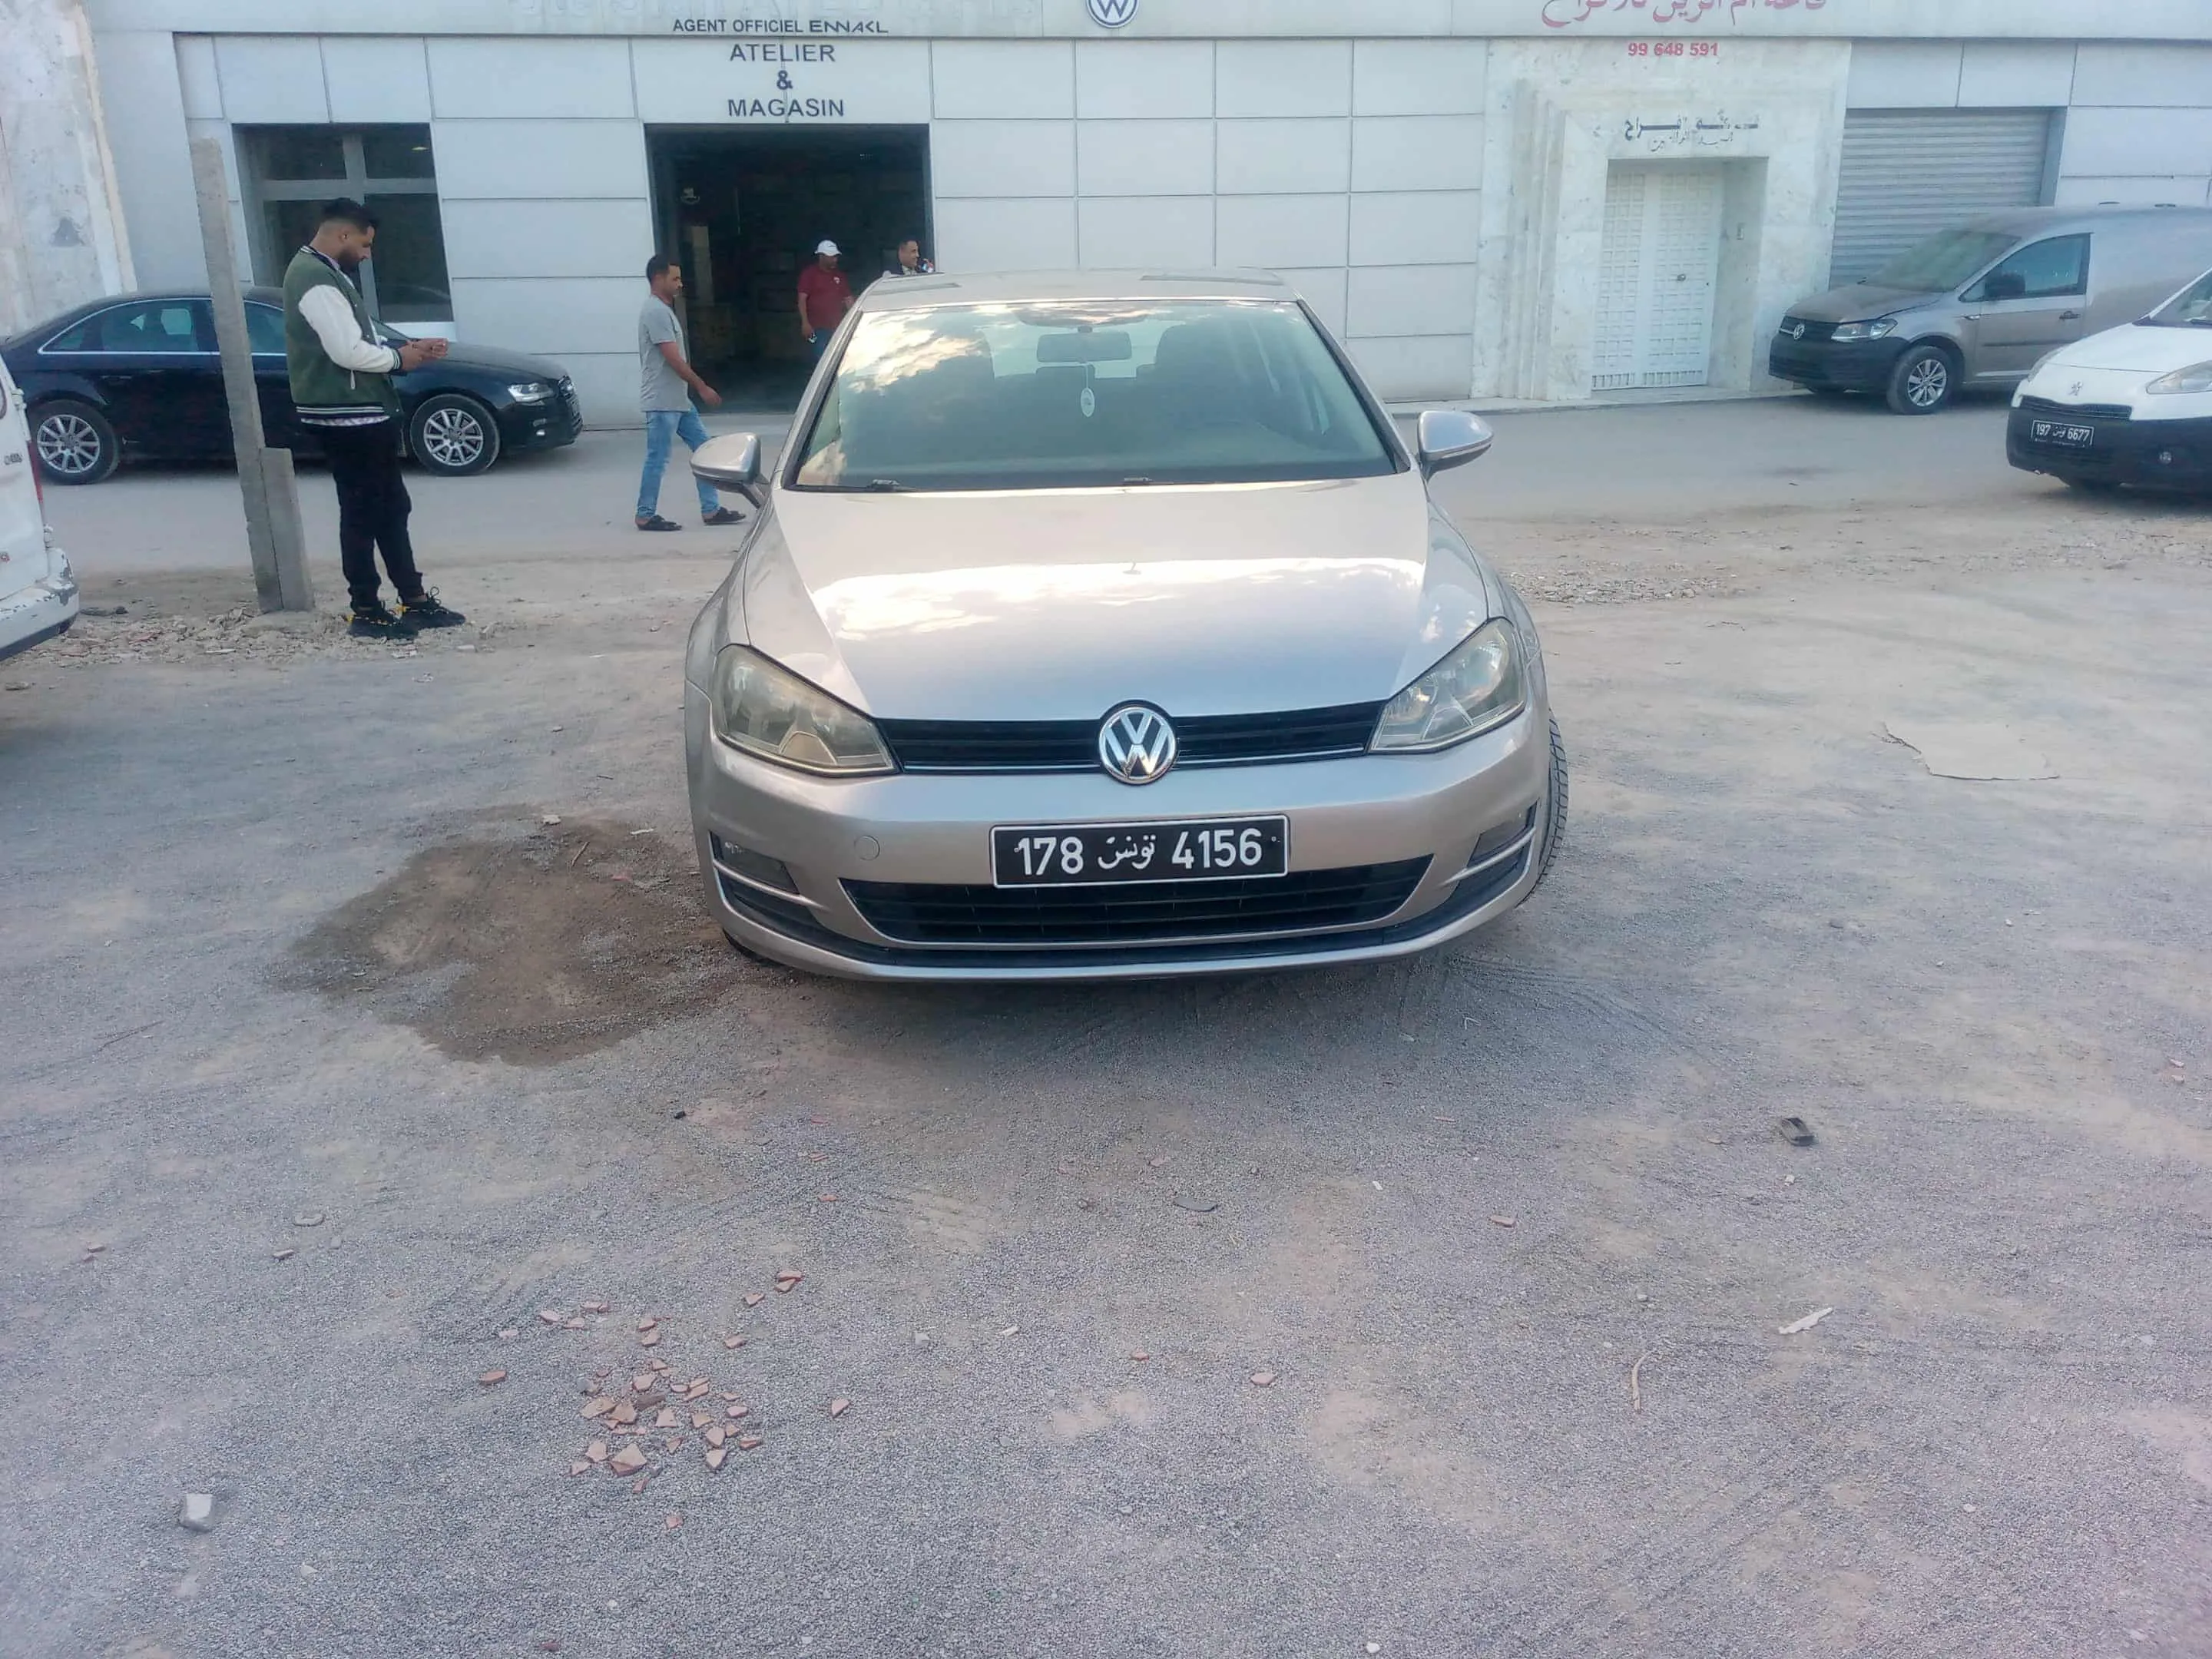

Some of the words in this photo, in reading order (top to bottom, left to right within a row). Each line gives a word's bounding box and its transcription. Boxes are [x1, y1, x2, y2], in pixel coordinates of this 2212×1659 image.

[673, 19, 728, 33] AGENT
[732, 18, 804, 34] OFFICIEL
[730, 43, 836, 62] ATELIER
[1628, 42, 1648, 56] 99
[1654, 42, 1684, 56] 648
[1689, 42, 1719, 56] 591
[776, 70, 793, 91] &
[727, 98, 844, 118] MAGASIN
[2036, 423, 2051, 436] 197
[2067, 428, 2090, 442] 6677
[1018, 836, 1084, 876] 178
[1097, 835, 1157, 870] تونس
[1171, 828, 1263, 870] 4156
